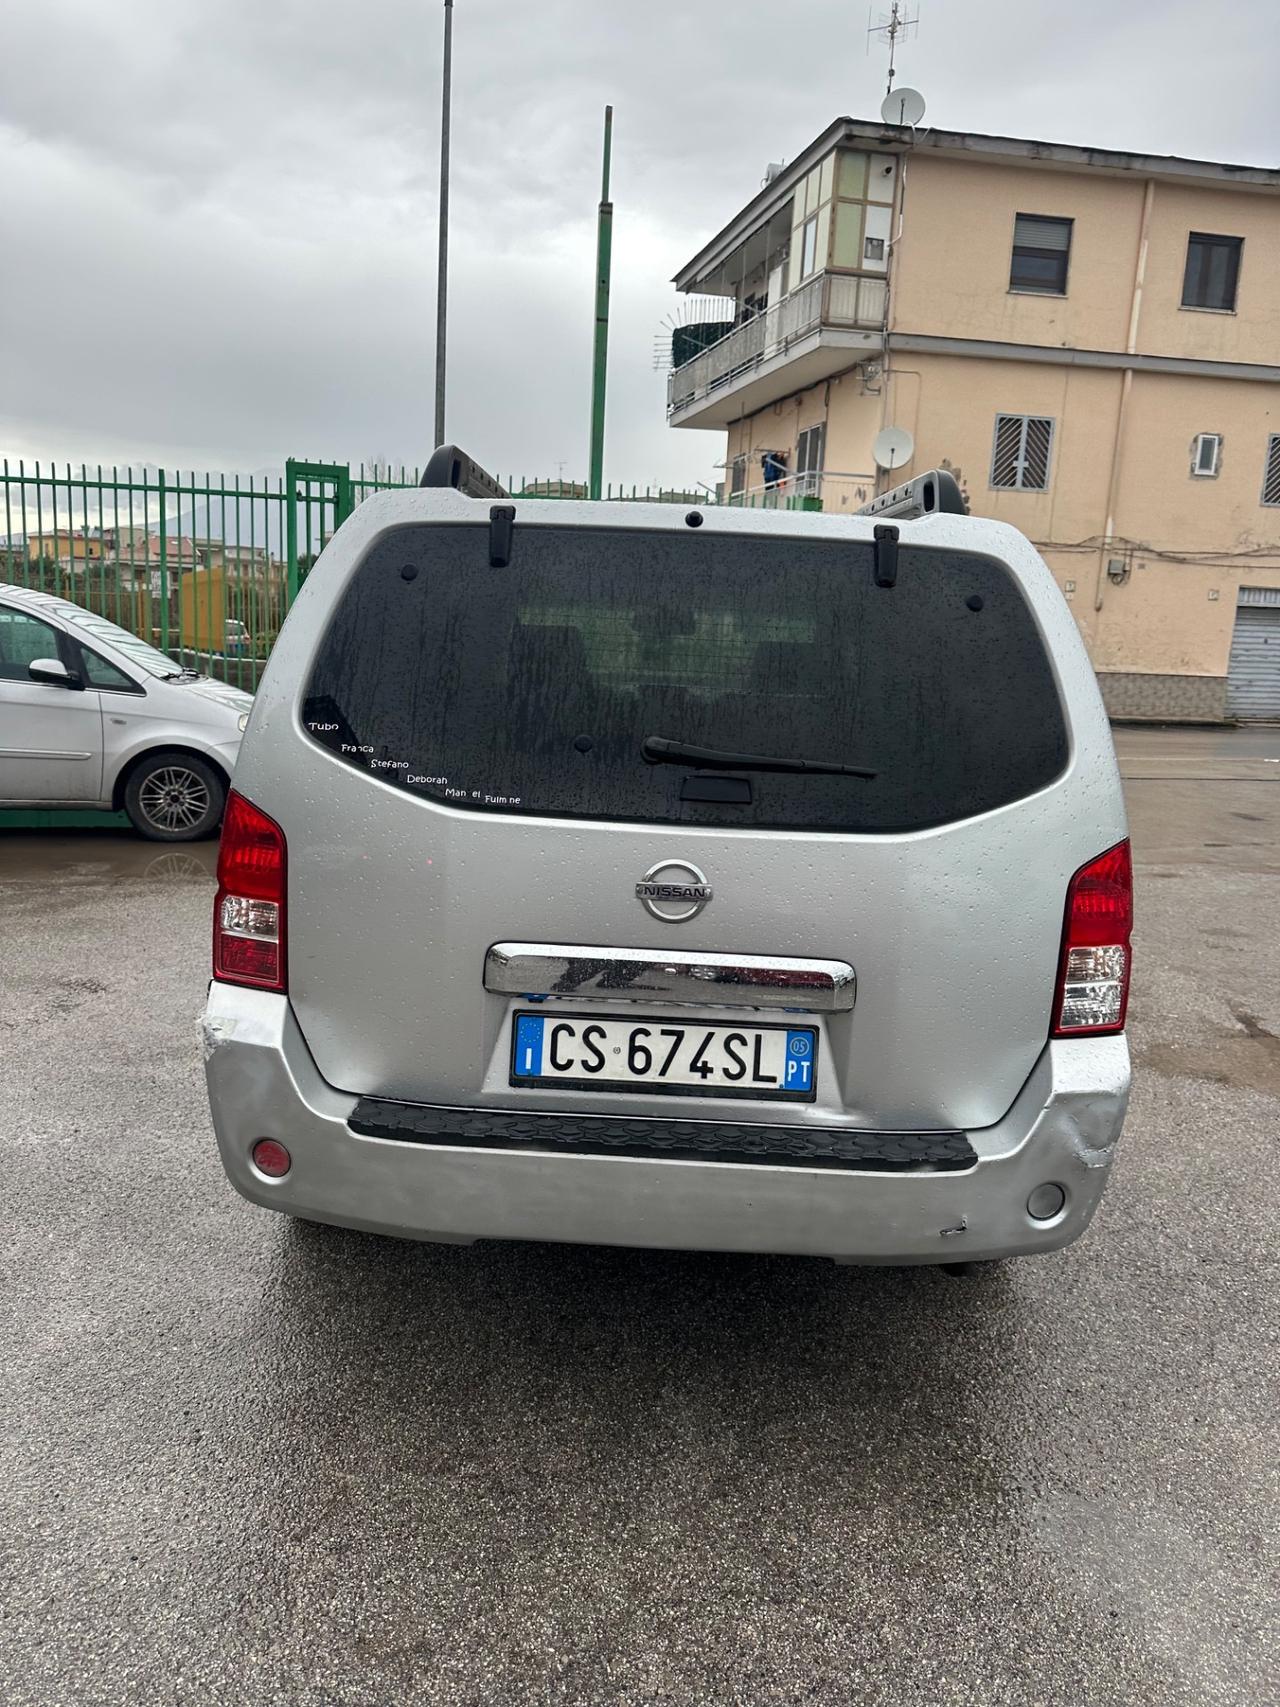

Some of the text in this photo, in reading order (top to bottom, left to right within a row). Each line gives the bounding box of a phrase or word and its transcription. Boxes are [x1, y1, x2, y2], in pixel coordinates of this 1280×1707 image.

[371, 759, 409, 768] Stefano
[407, 775, 448, 785] Deborah
[644, 887, 705, 897] NISSAN
[793, 1040, 806, 1053] 05
[787, 1060, 811, 1083] PT
